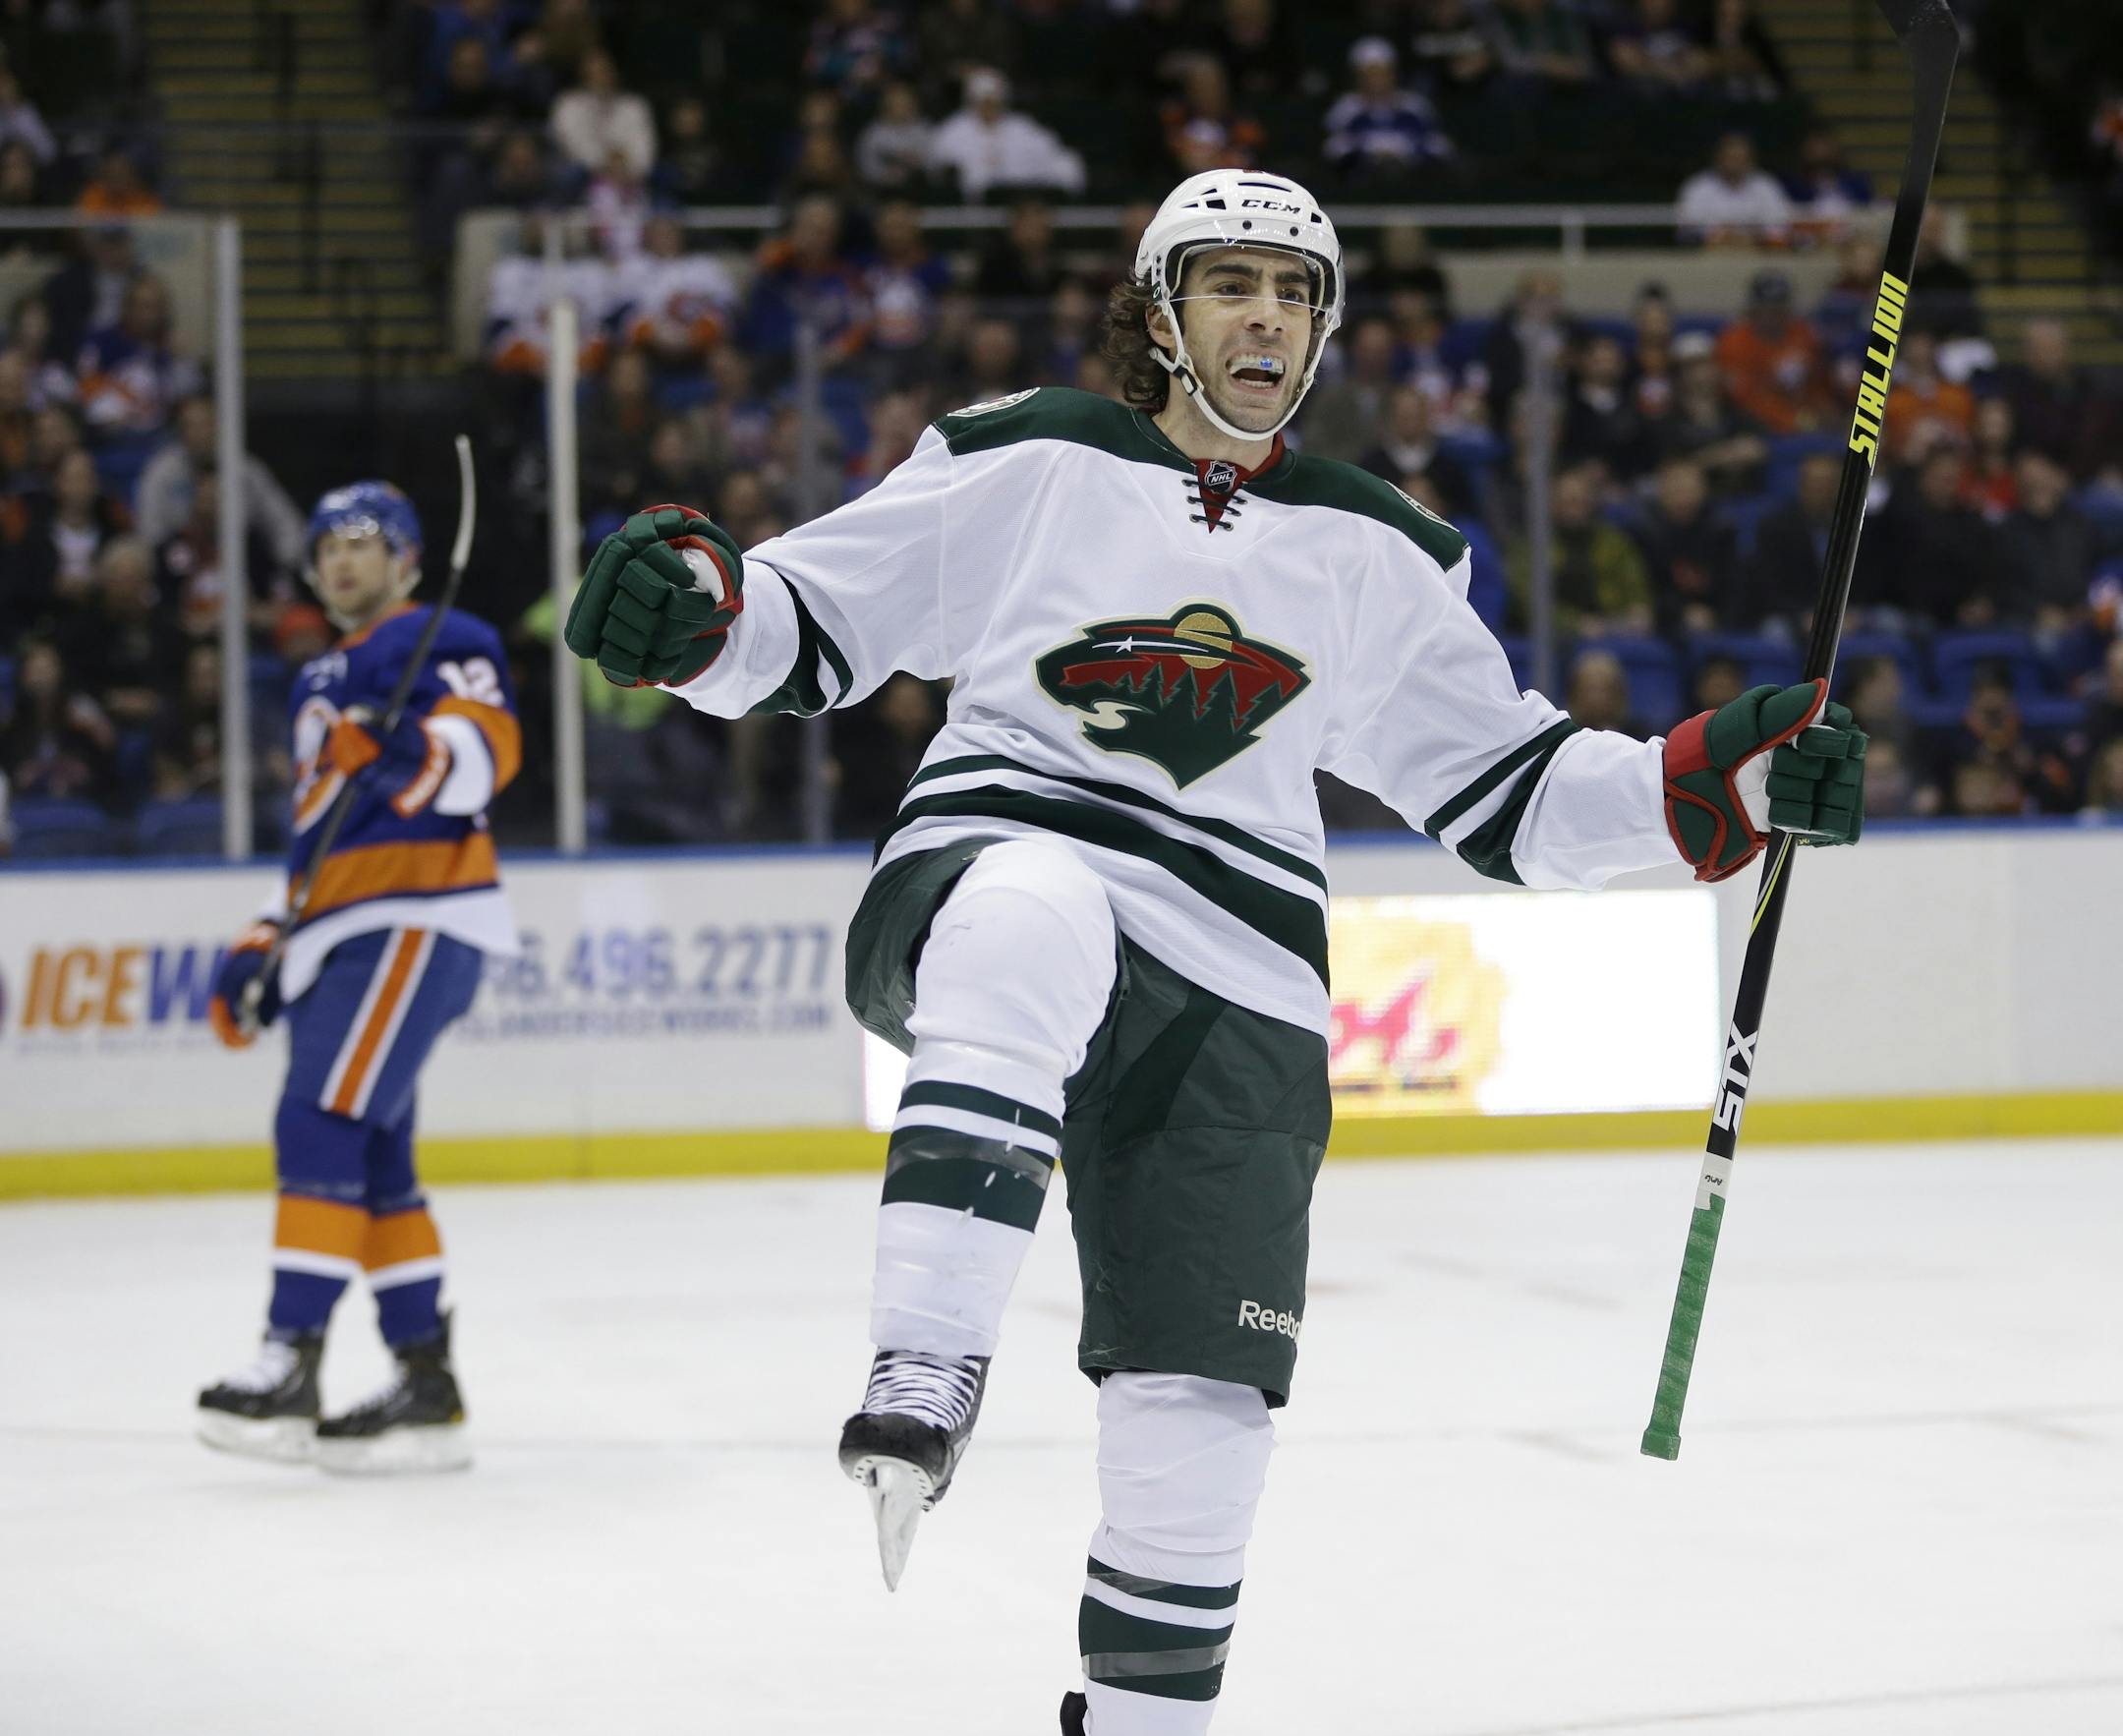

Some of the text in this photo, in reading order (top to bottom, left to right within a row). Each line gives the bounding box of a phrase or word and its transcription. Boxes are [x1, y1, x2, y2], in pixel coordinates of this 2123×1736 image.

[1241, 199, 1301, 214] CCM
[1848, 270, 1909, 469] STALLION
[1210, 473, 1232, 484] NHL
[436, 657, 505, 707] 12
[22, 946, 232, 1028] ICEW
[491, 926, 833, 999] 6.496.2277
[1713, 1021, 1757, 1135] STX
[1238, 1299, 1302, 1344] Reebo
